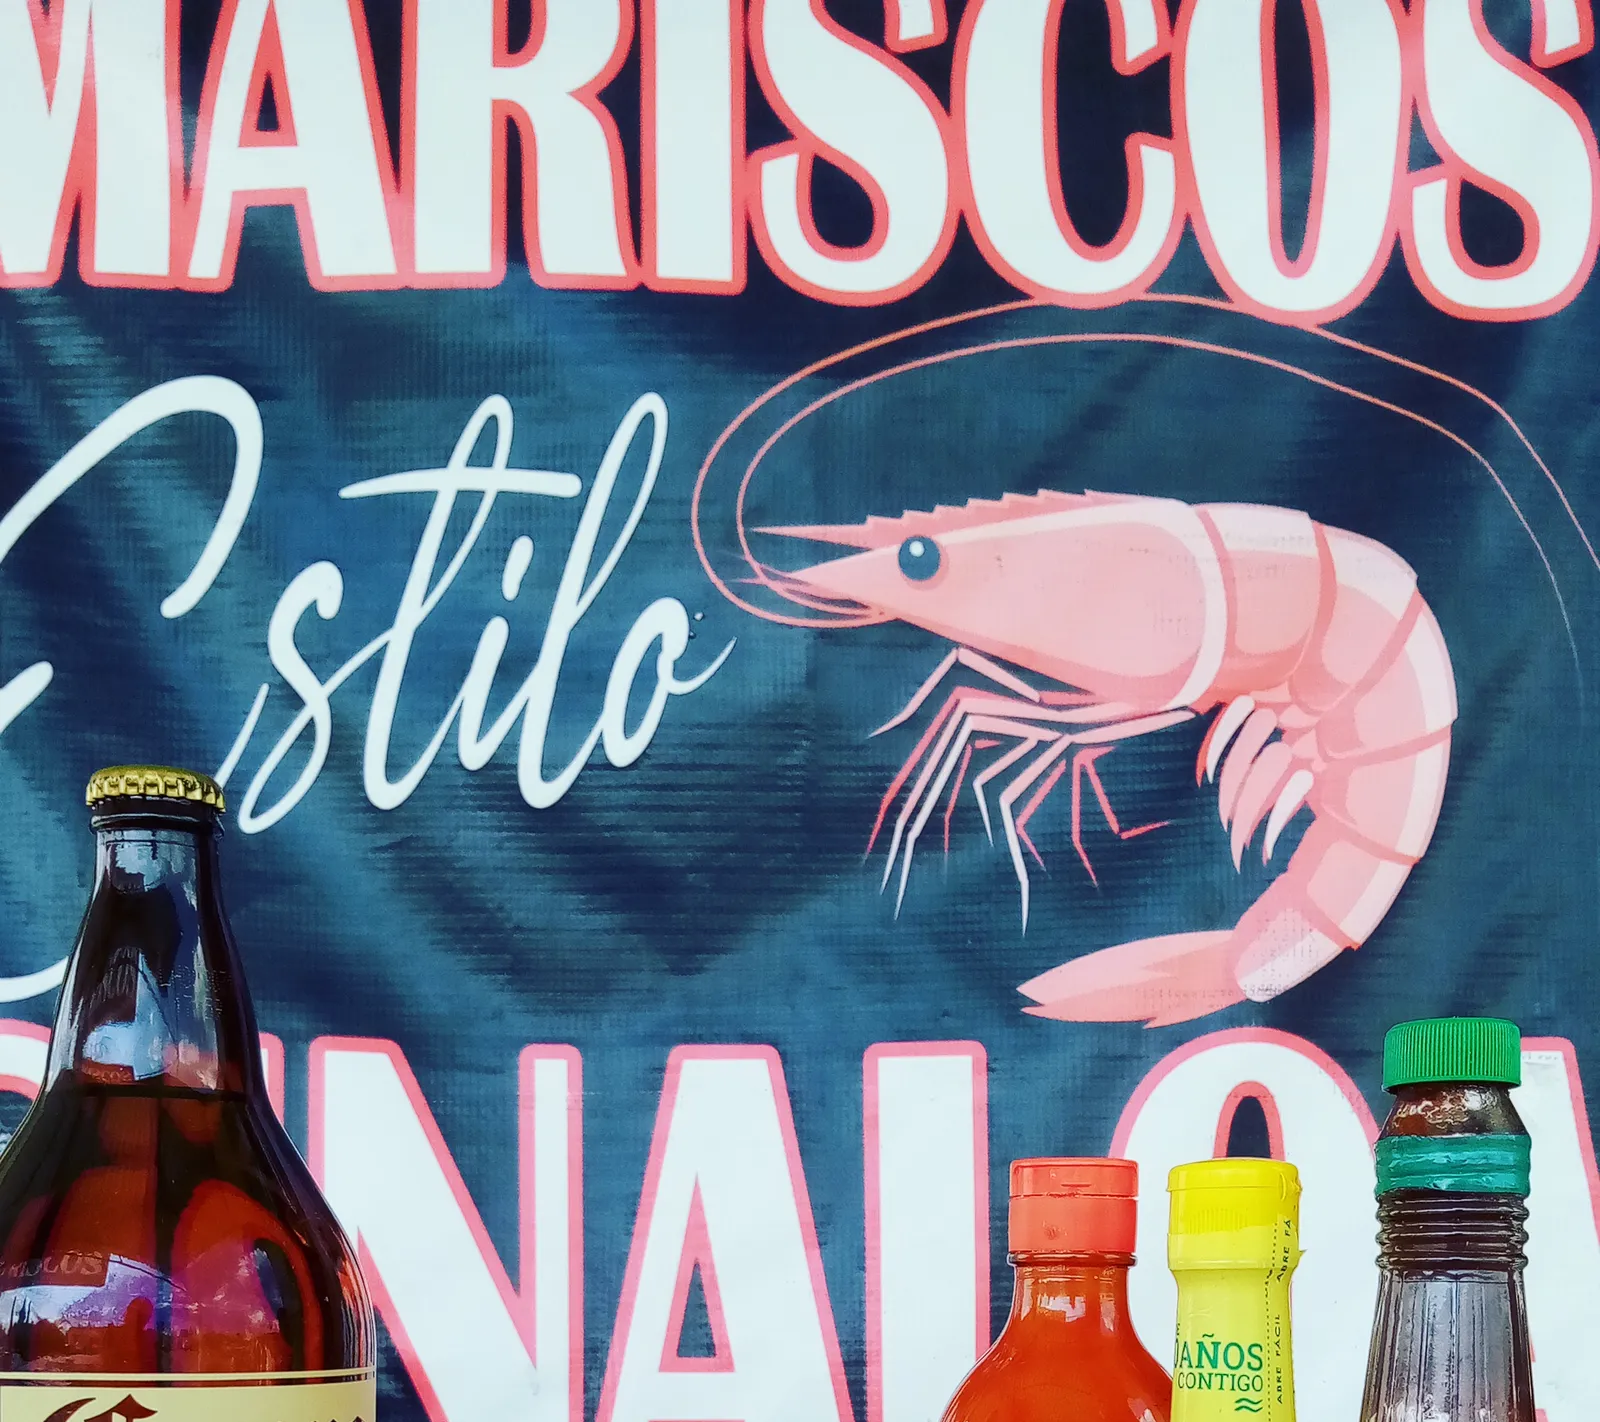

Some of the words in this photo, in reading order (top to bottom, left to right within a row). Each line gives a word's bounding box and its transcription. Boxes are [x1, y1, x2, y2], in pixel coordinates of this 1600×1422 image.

[0, 0, 1600, 322] MARISCOS
[1276, 1246, 1290, 1283] ABRE
[1177, 1371, 1264, 1392] CONTIGO
[1275, 1367, 1283, 1404] ABRE
